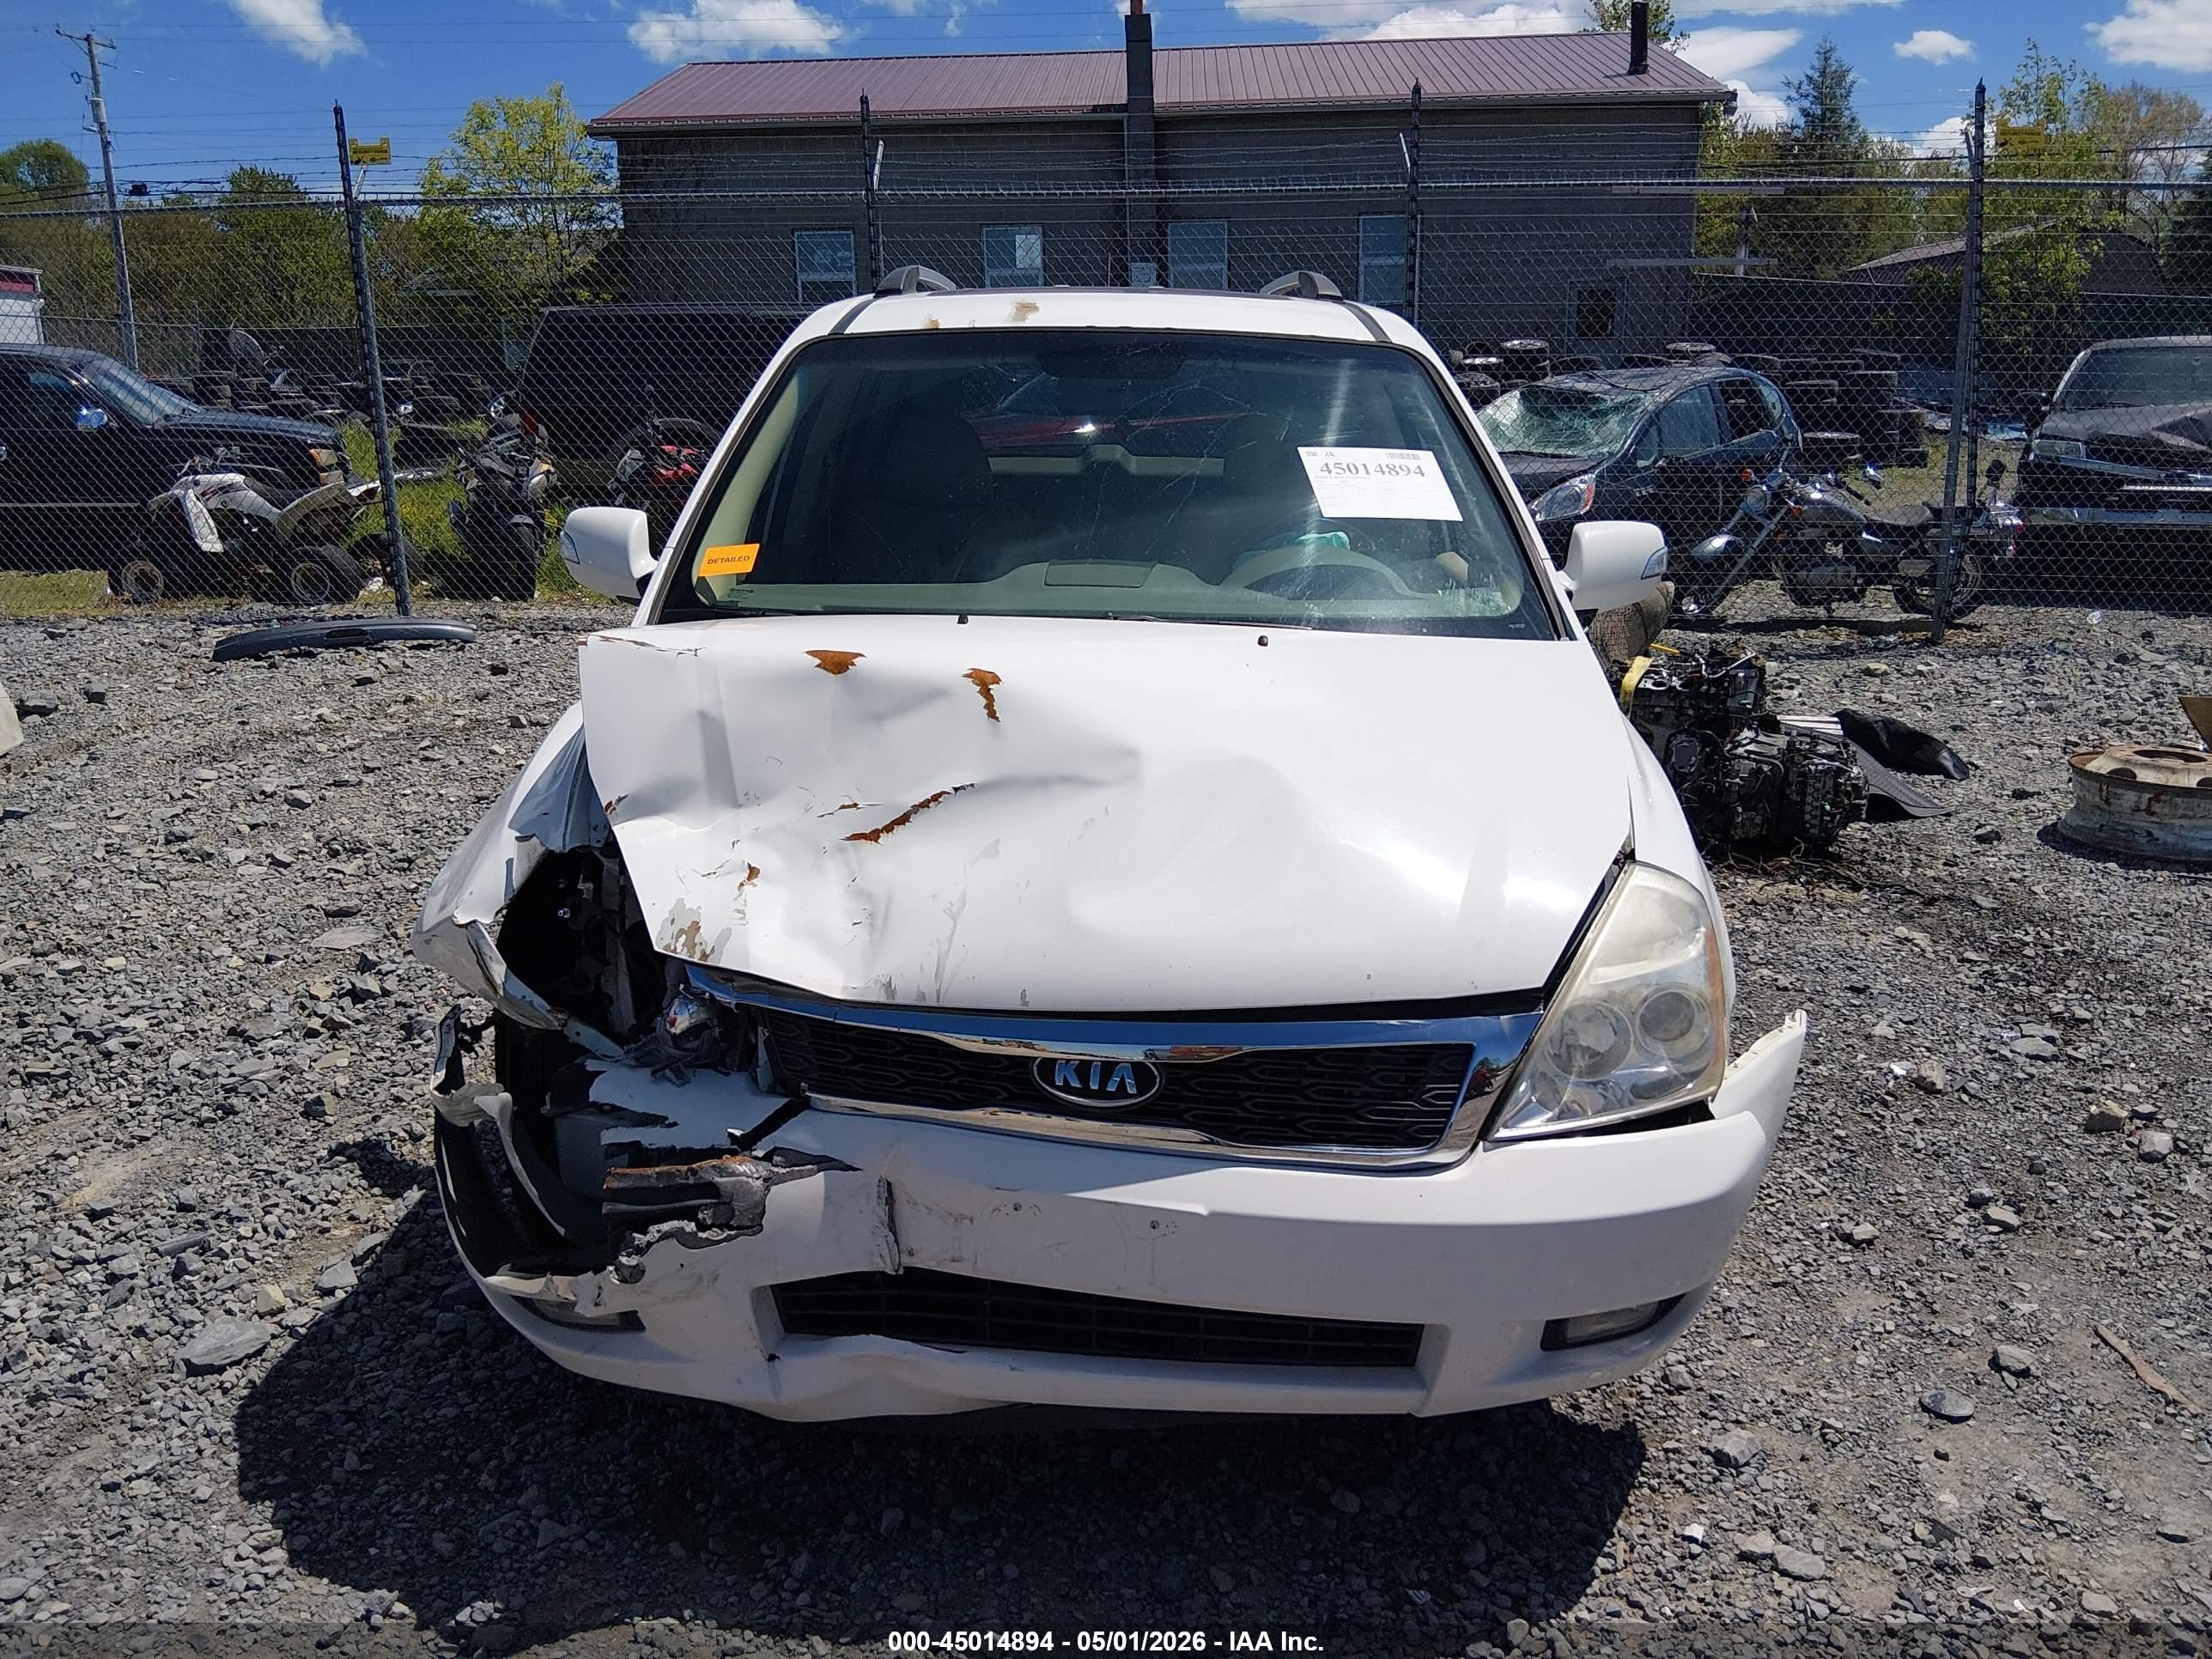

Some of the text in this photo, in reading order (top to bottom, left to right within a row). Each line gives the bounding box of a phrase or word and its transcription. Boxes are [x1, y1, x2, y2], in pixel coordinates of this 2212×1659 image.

[1320, 462, 1426, 477] 45014894
[707, 555, 750, 565] DETAILED
[1054, 1060, 1138, 1095] KIA
